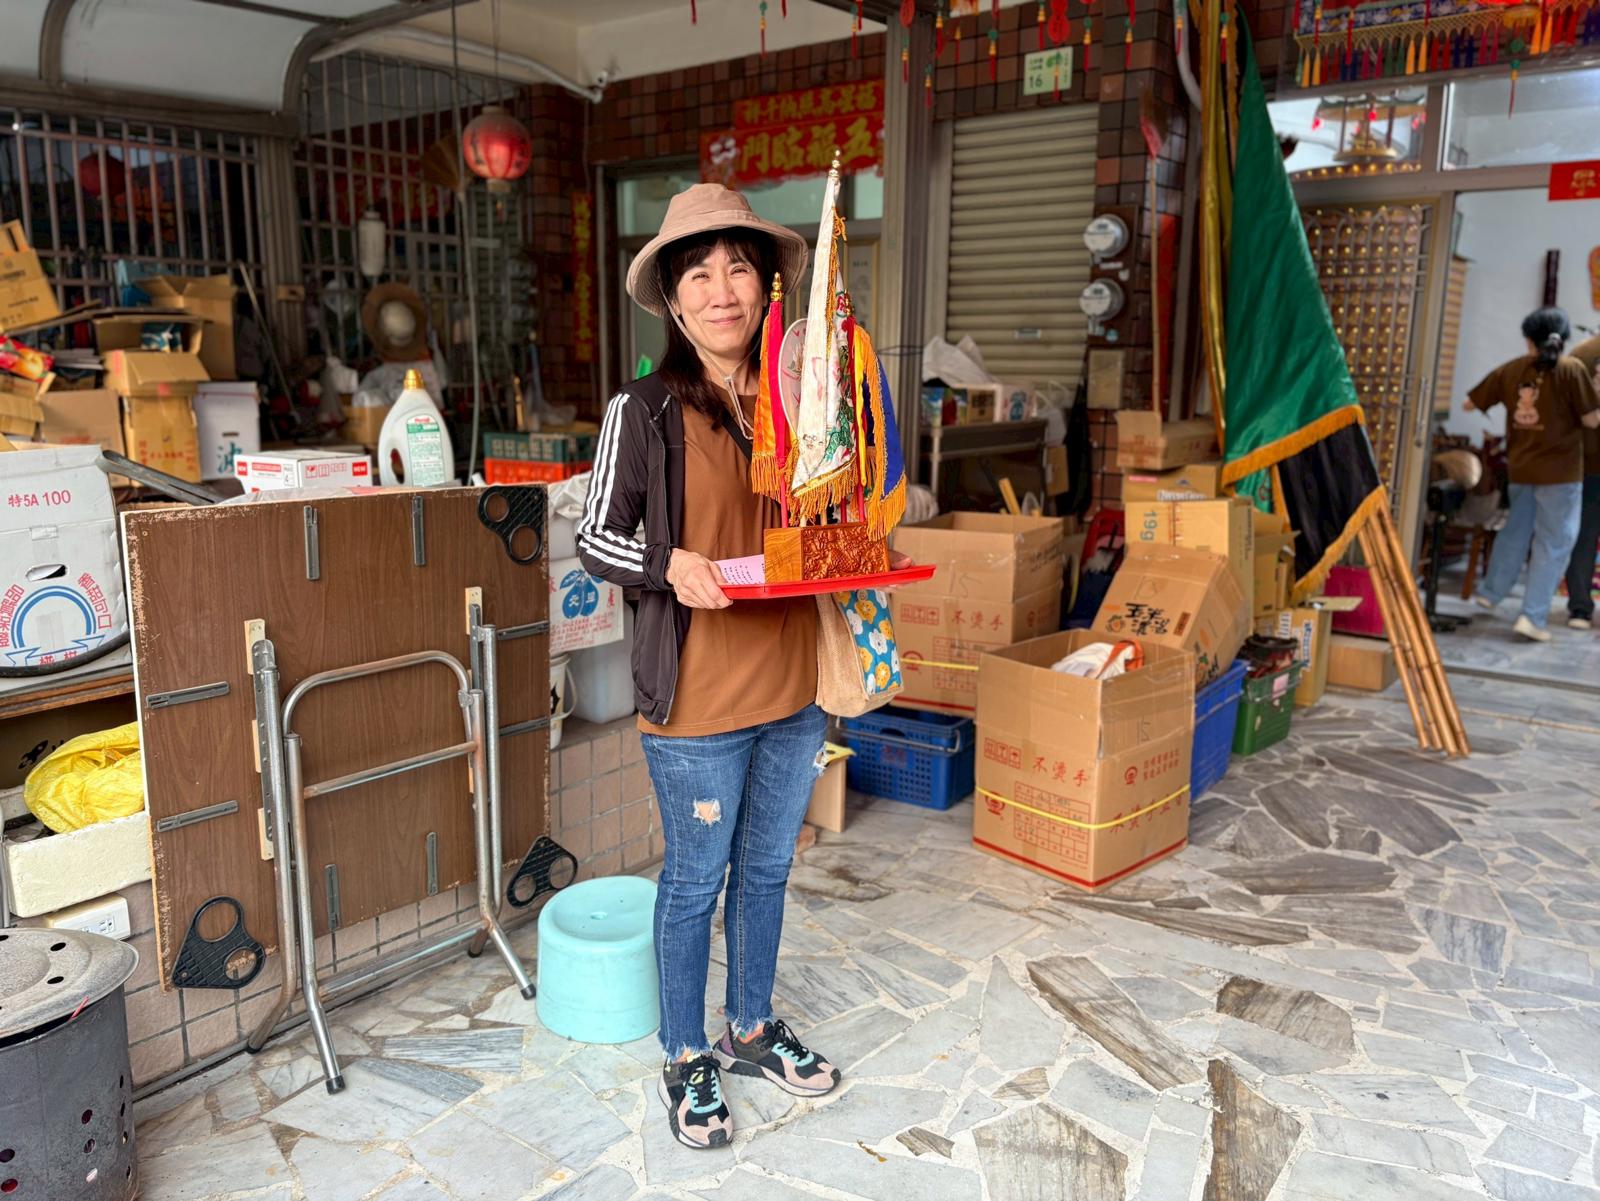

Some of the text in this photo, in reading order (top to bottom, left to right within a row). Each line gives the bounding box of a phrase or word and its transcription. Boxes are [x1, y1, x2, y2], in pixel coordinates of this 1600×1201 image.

[1029, 75, 1043, 88] 16
[42, 489, 71, 506] 100
[1032, 757, 1088, 787] 不燙手
